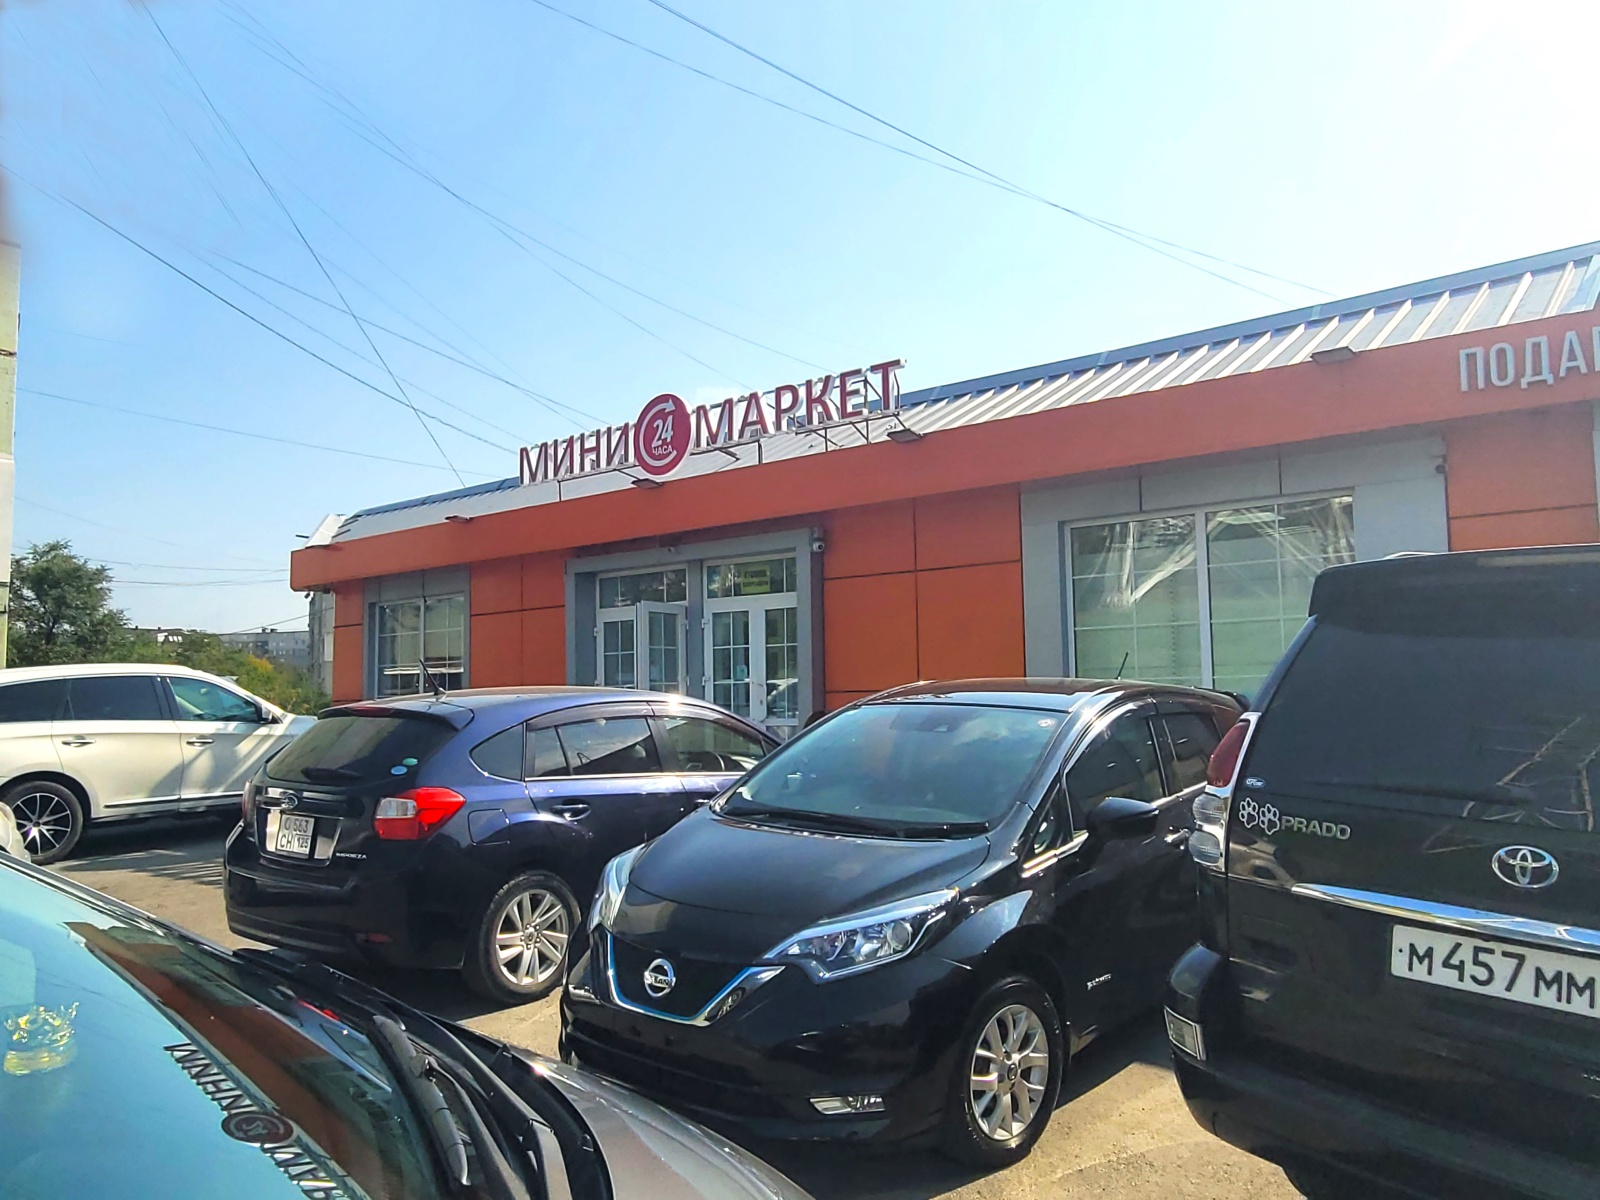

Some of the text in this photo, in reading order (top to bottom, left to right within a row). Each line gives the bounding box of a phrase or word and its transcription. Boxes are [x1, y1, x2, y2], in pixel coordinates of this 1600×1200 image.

[519, 359, 906, 485] МИНИ МАРКЕТ
[652, 415, 673, 447] 24
[652, 445, 672, 455] ЧАСА
[1281, 816, 1351, 840] PRADO
